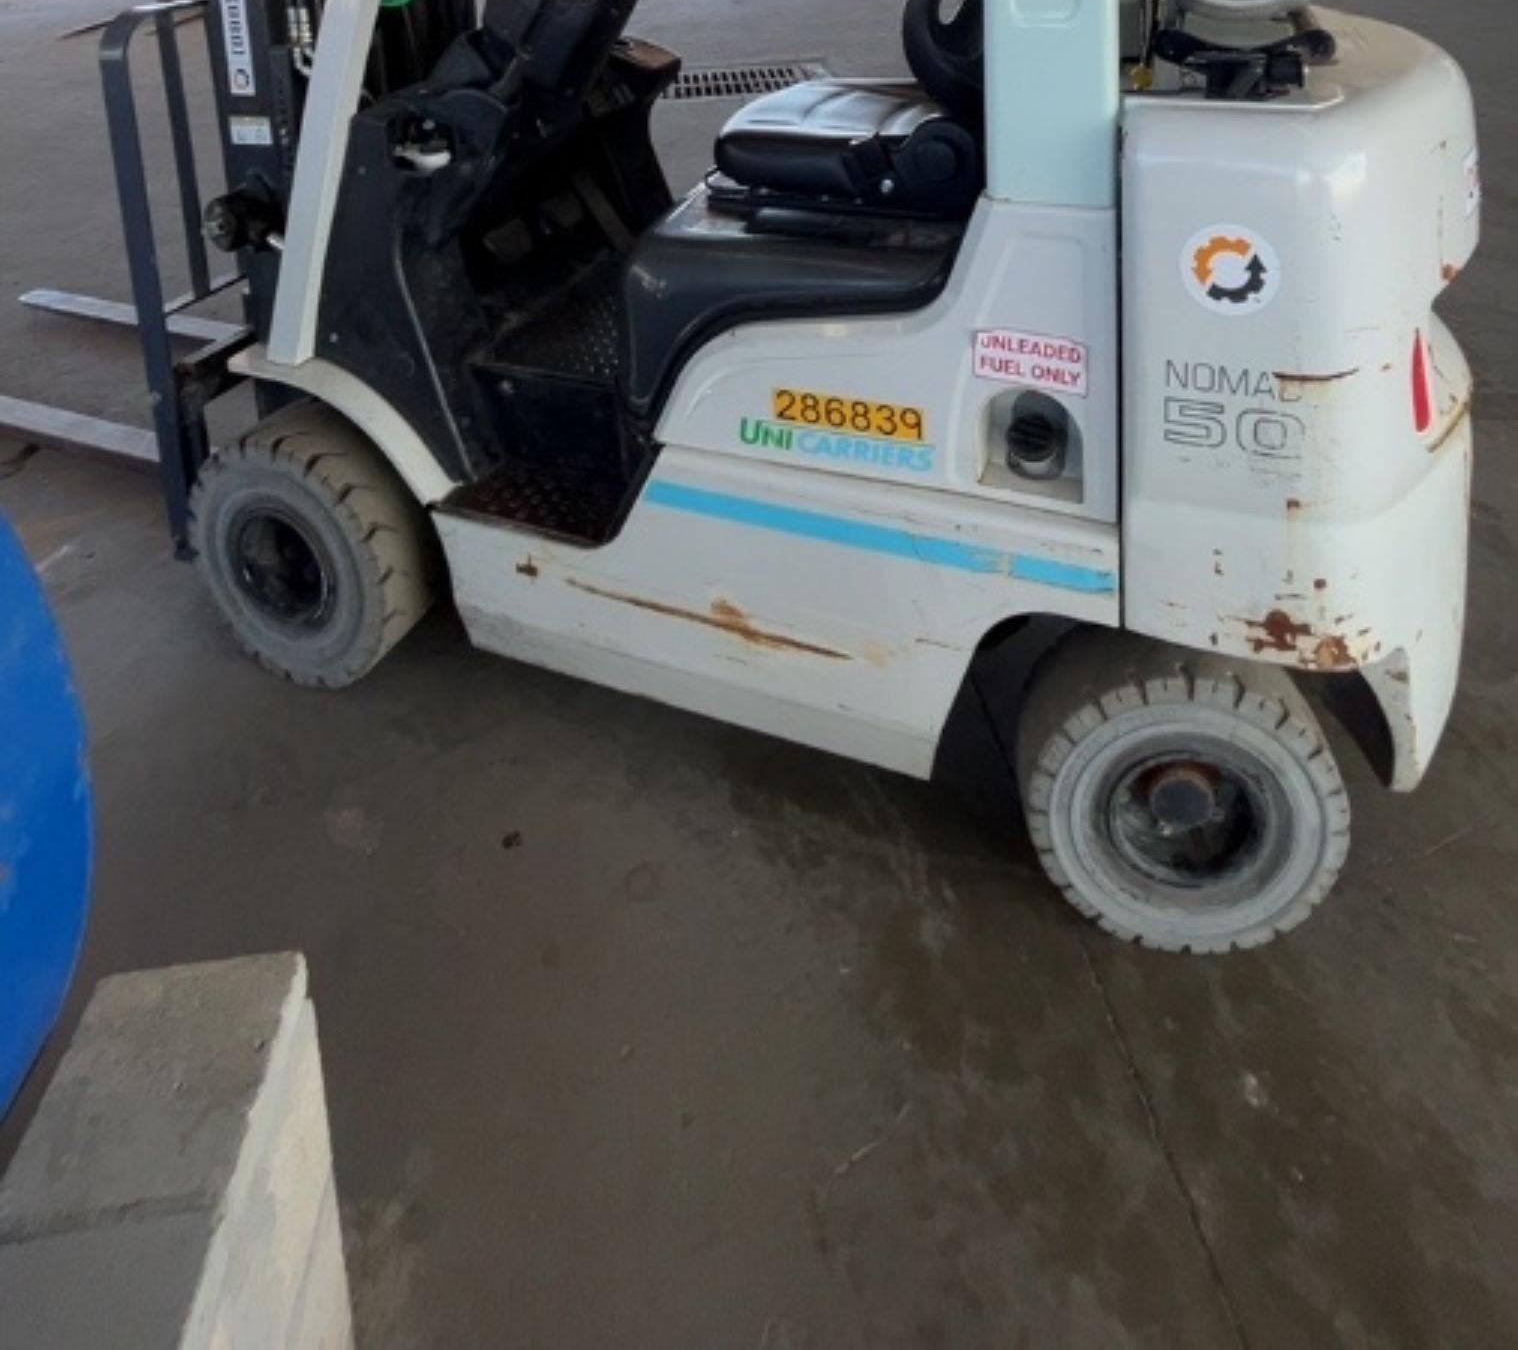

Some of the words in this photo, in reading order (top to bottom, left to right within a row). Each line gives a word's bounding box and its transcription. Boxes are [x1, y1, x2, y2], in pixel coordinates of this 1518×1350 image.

[981, 335, 1081, 364] UNLEADED
[981, 355, 1024, 376] FUEL
[1031, 365, 1080, 386] ONLY
[775, 389, 923, 441] 286839
[1163, 396, 1306, 460] 50
